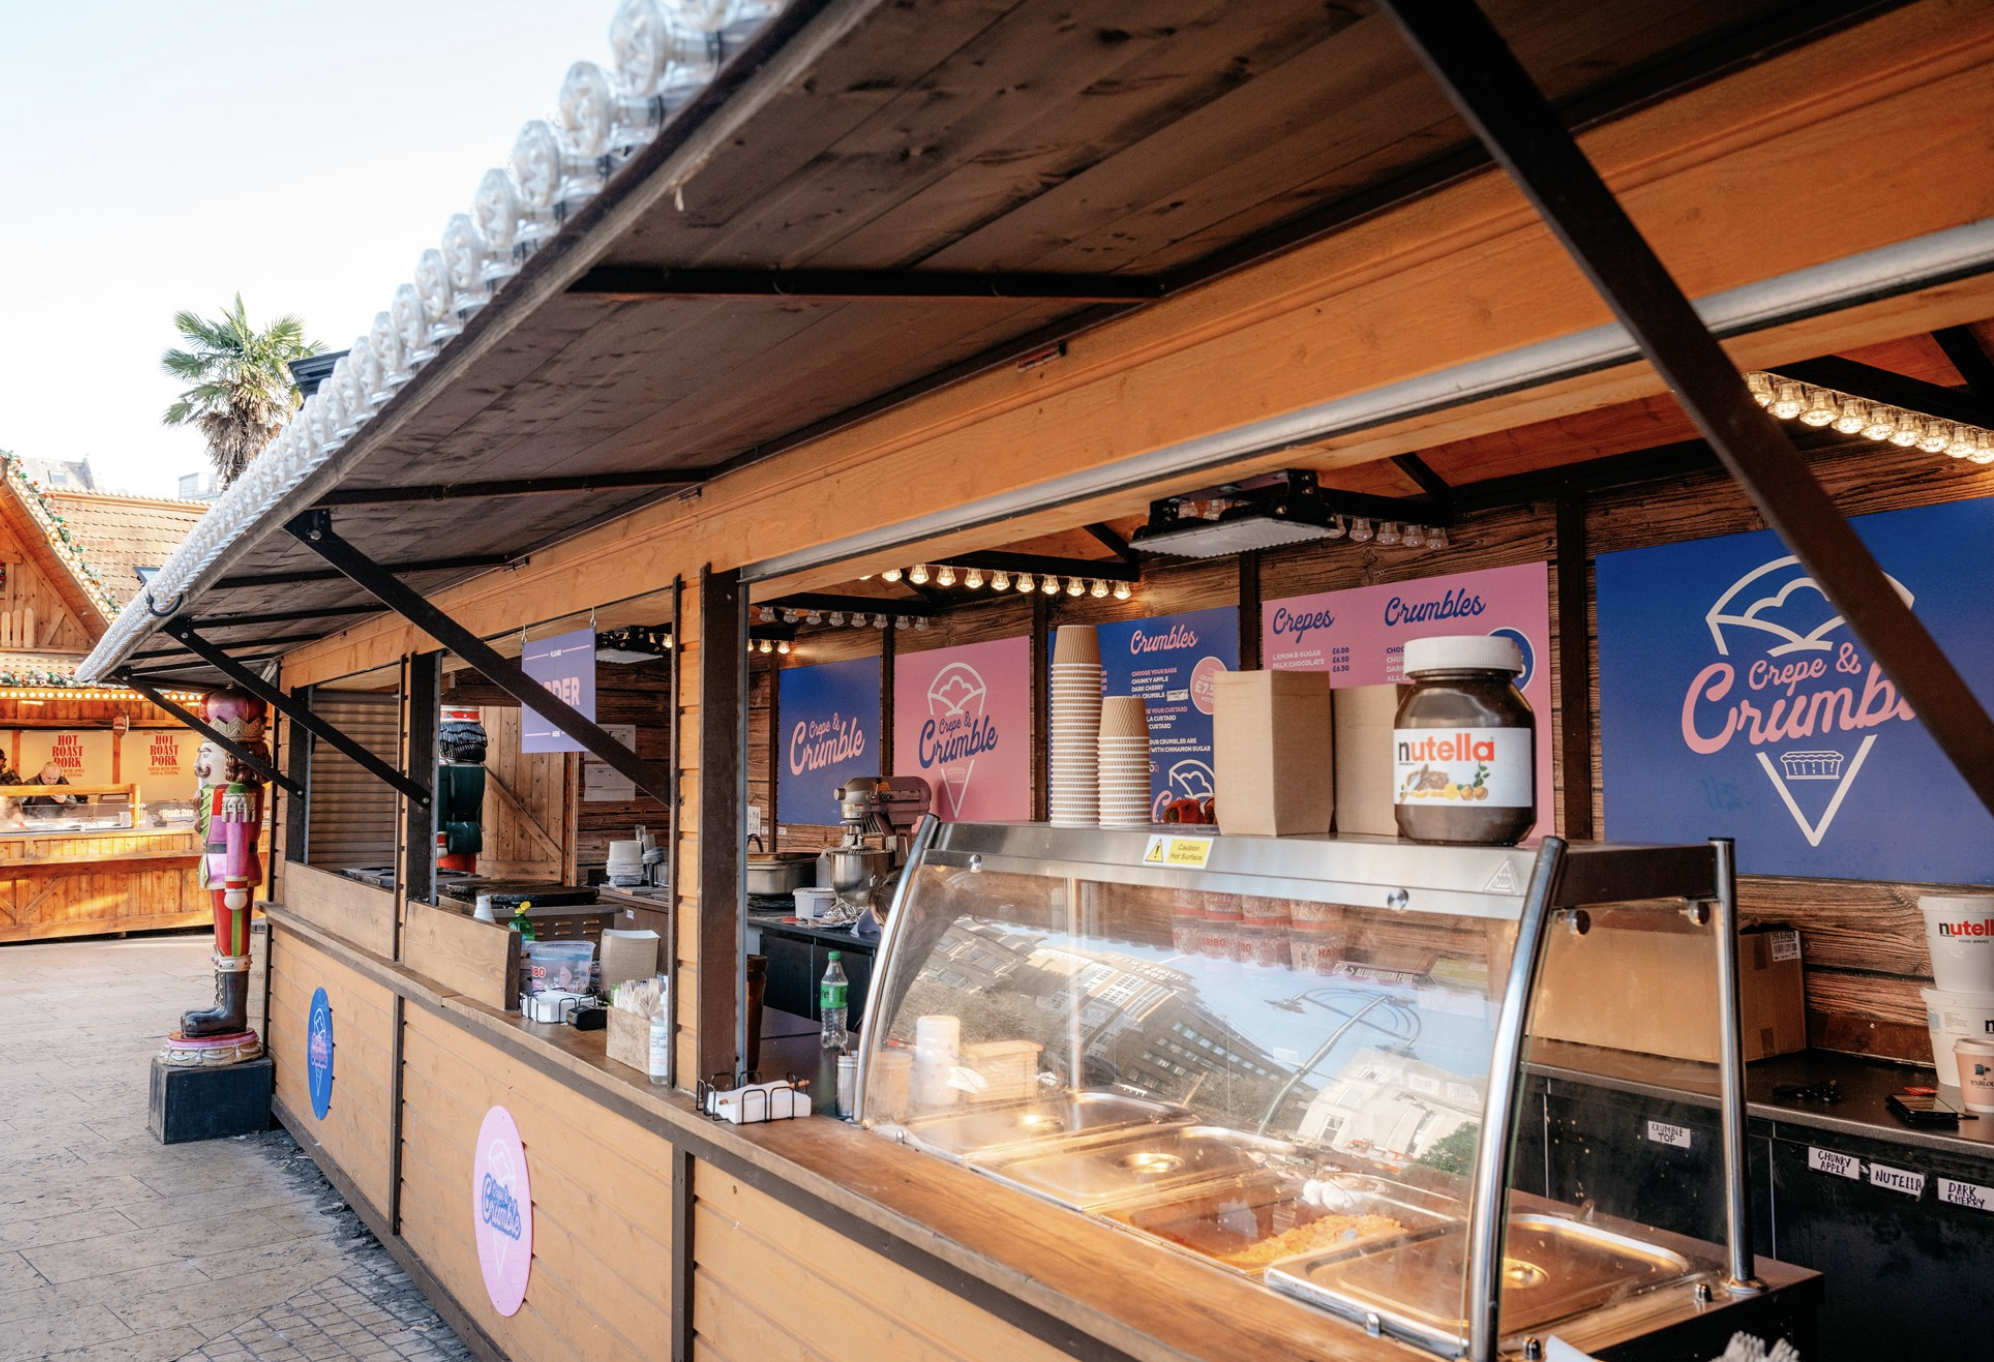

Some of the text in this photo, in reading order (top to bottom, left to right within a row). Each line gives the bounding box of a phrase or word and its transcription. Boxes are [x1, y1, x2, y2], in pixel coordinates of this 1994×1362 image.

[1385, 588, 1486, 626] Crumbles
[1273, 607, 1335, 644] Crepes
[1131, 624, 1198, 654] Crumbles
[1272, 652, 1293, 660] LEMON
[1300, 650, 1321, 658] SUGAR
[1332, 647, 1350, 655] £6.00
[1289, 658, 1325, 667] CHOCOLATE
[1332, 656, 1350, 664] £6.50
[1332, 665, 1350, 673] £6.50
[1386, 665, 1404, 673] DAR
[1749, 642, 1861, 696] Crepe &
[1681, 660, 1917, 754] Crumb
[808, 719, 831, 742] Crepe
[939, 719, 961, 739] Crepe
[57, 734, 78, 746] HOT
[155, 734, 174, 744] HOT
[919, 714, 999, 769] Crumble
[52, 746, 84, 757] ROAST
[150, 745, 179, 755] ROAST
[790, 717, 865, 776] Crumble
[1398, 733, 1494, 762] nutella
[53, 757, 82, 768] PORK
[151, 756, 178, 766] PORK
[1178, 844, 1200, 852] Caution
[1181, 853, 1203, 861] Surface
[1939, 919, 1994, 936] nutell
[1651, 1123, 1684, 1137] CRUMBLE
[1657, 1132, 1676, 1143] TOP
[1818, 1150, 1851, 1168] CHUNKY
[1820, 1161, 1847, 1175] APPLE
[1948, 1181, 1977, 1200] DARK
[1947, 1193, 1986, 1209] CHERRY
